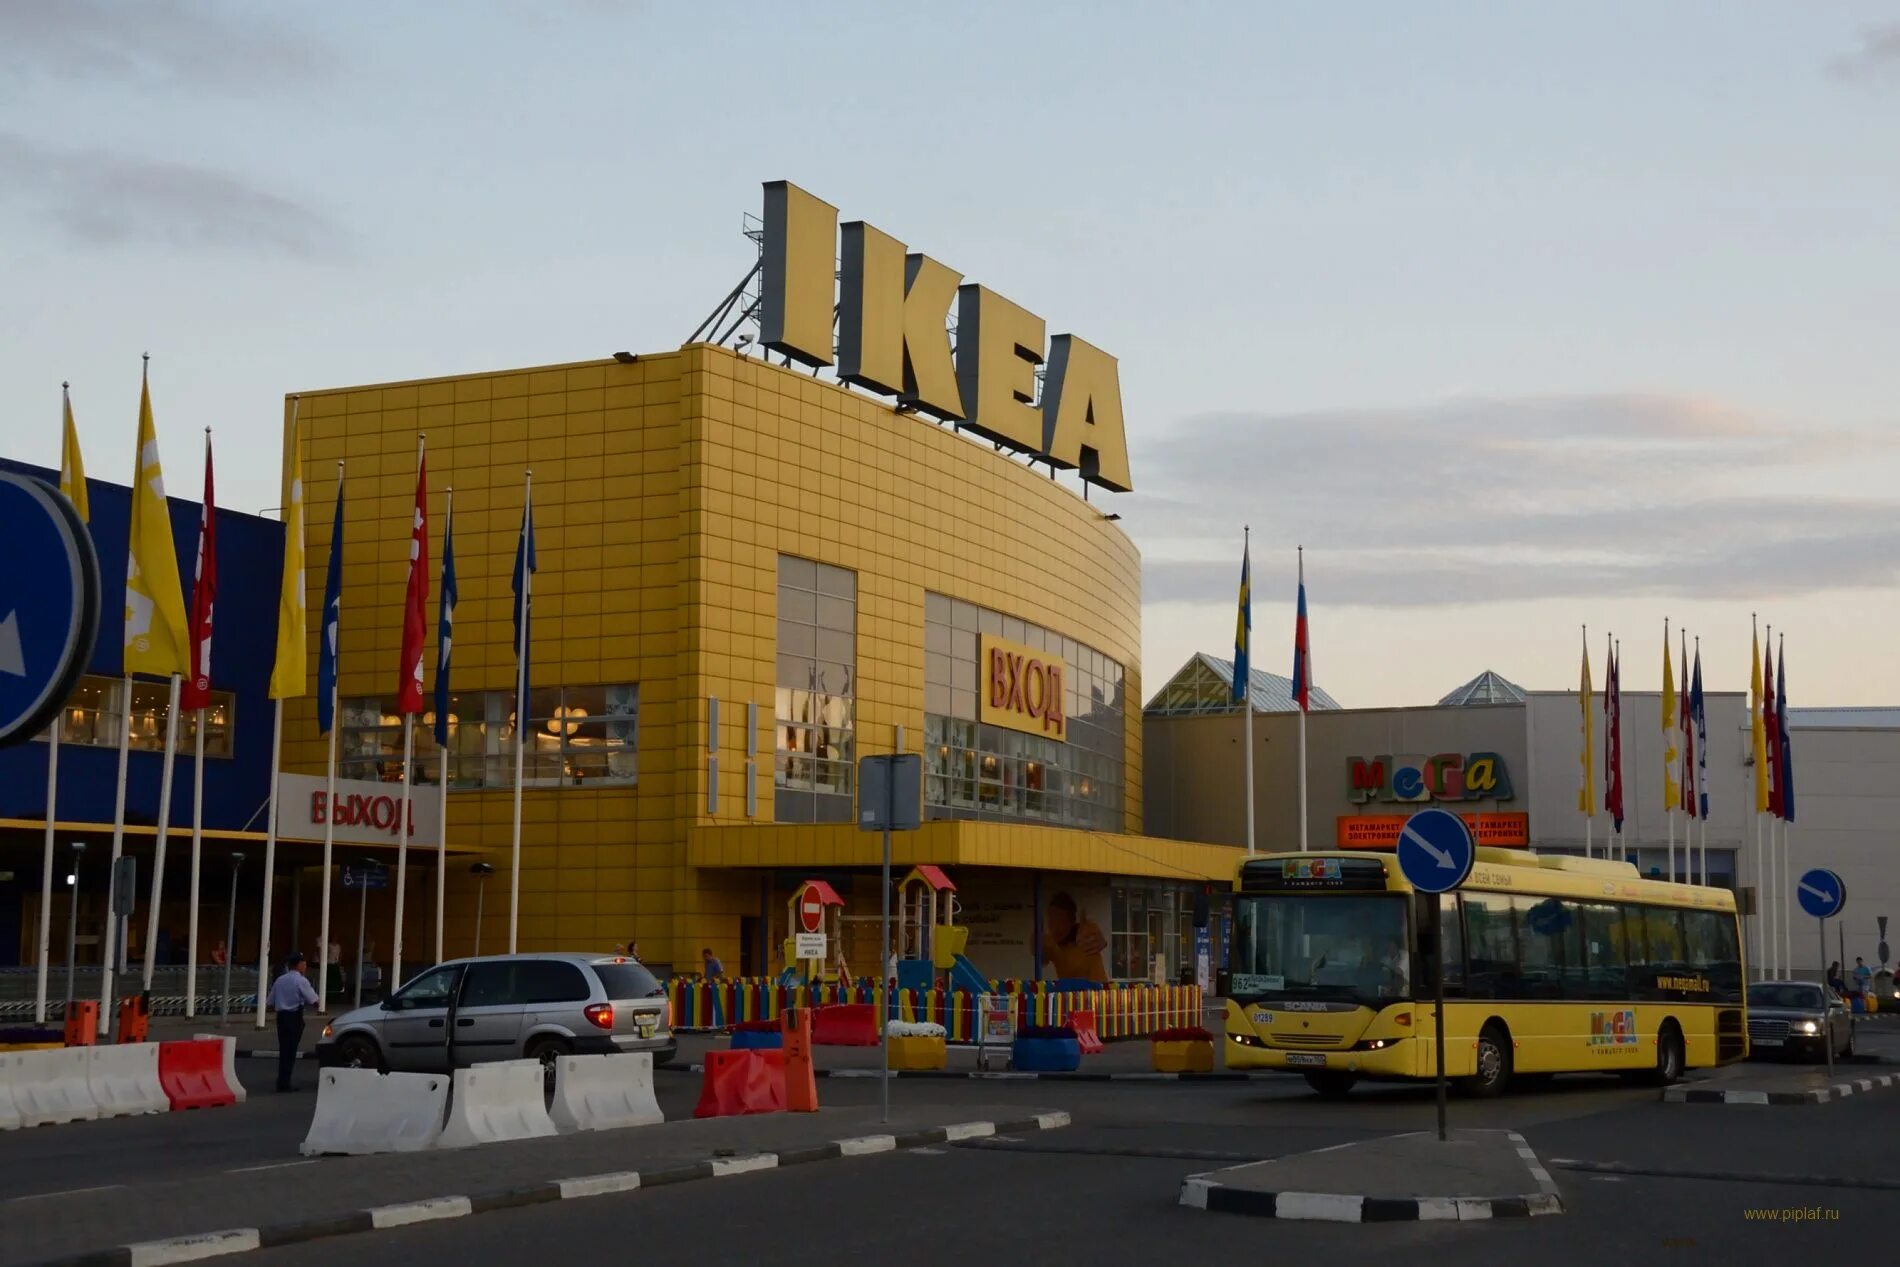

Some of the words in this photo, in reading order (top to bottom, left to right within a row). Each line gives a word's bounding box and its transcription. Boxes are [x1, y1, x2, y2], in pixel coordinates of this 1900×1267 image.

[762, 180, 1134, 493] IKEA
[991, 647, 1063, 735] ВХОД
[311, 791, 414, 836] ВЫХОД
[1348, 823, 1400, 831] МЕГАМАРКЕТ
[1468, 821, 1522, 829] МГАМАРКЕТ
[1474, 830, 1523, 838] ЕКТРОНИКИ
[1232, 977, 1248, 990] 962
[1283, 1001, 1328, 1011] SCANIA
